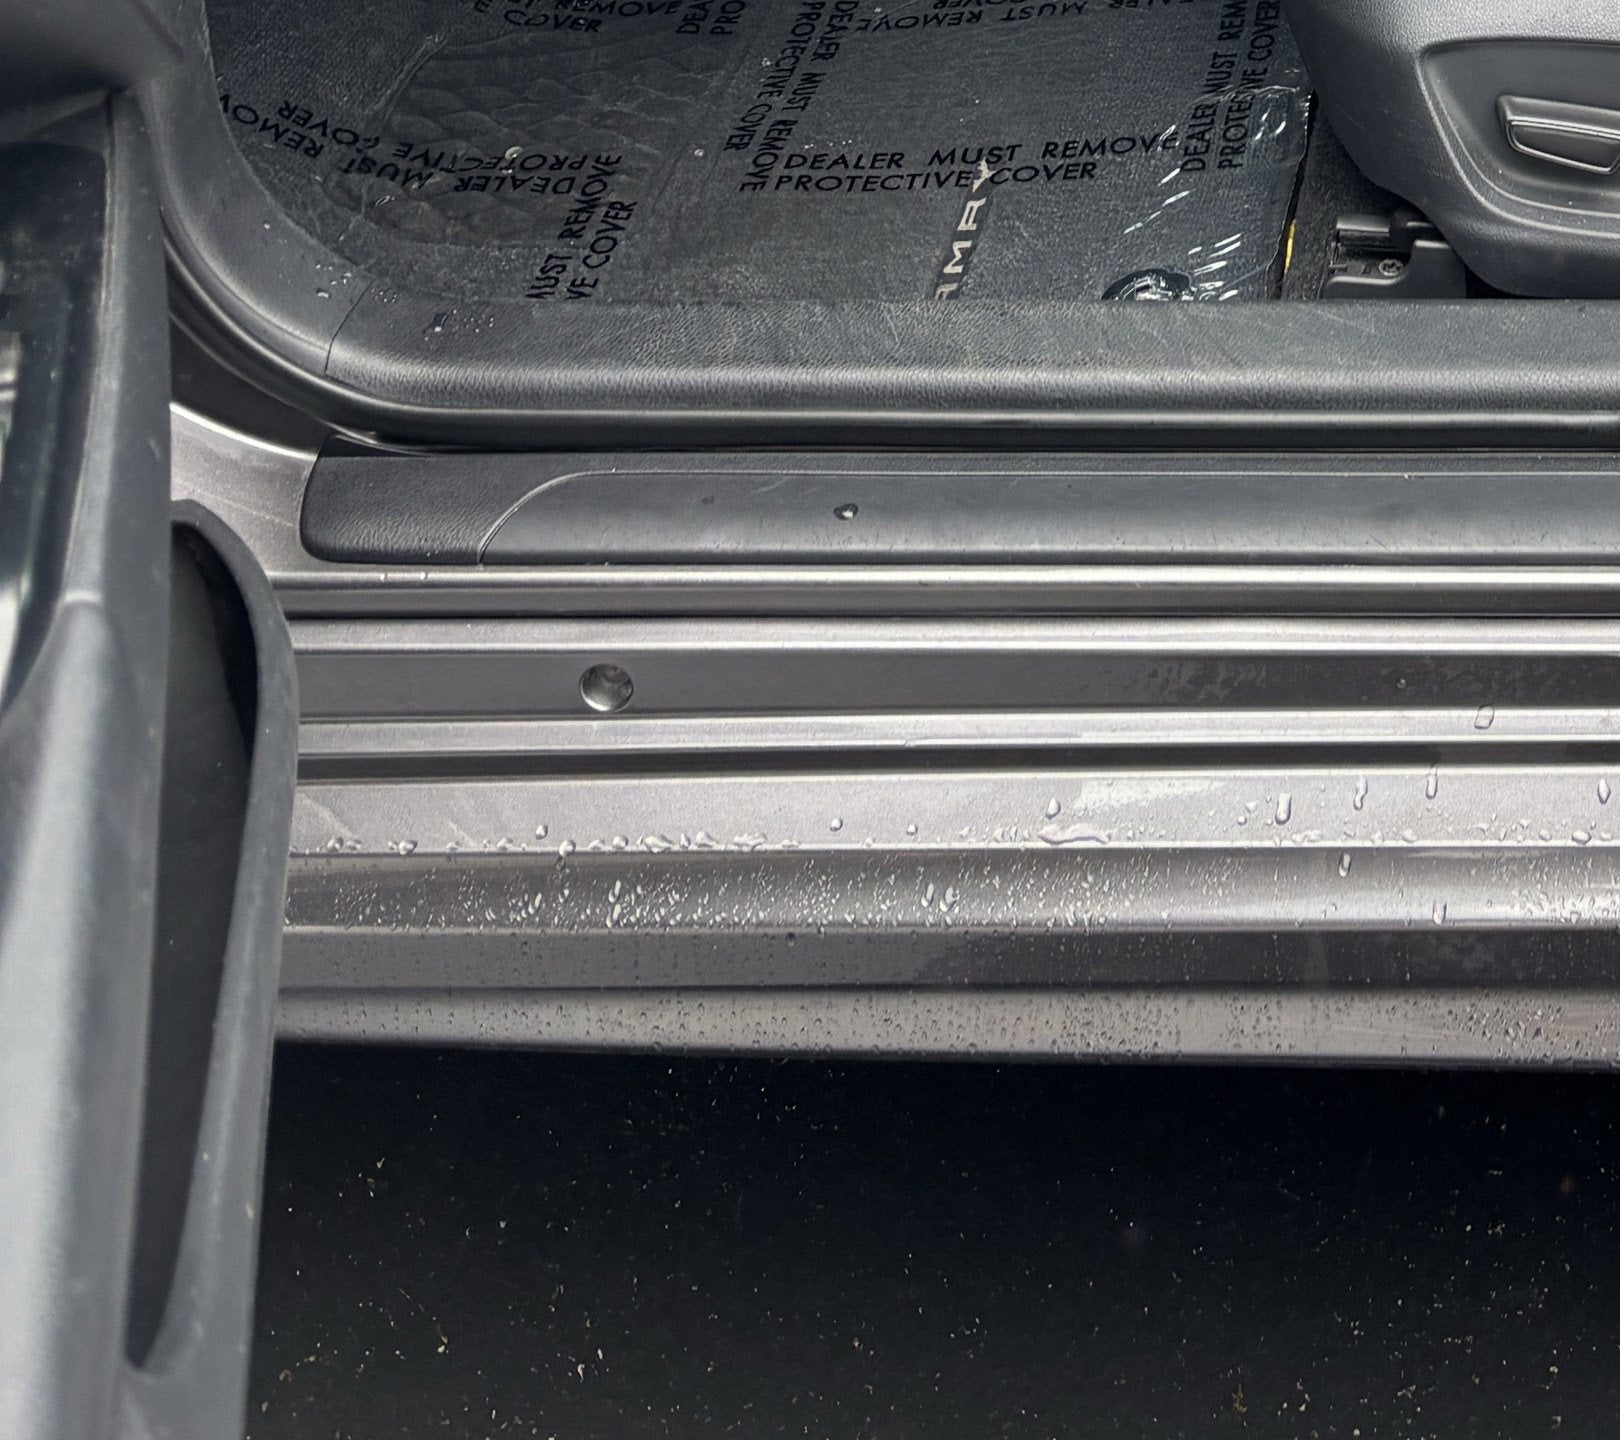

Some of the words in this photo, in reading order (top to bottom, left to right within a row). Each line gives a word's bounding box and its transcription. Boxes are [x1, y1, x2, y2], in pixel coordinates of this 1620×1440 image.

[503, 9, 602, 32] COVER
[854, 9, 983, 32] REMOVE
[1001, 0, 1087, 21] MUST
[757, 1, 825, 99] PROTECTIVE
[811, 0, 860, 62] DEALER
[1248, 0, 1282, 61] COVER
[782, 73, 827, 111] MUST
[724, 104, 772, 151] COVER
[1180, 103, 1219, 172] DEALER
[1202, 52, 1238, 94] MUST
[393, 142, 588, 172] PROTECTIVE
[739, 120, 798, 192] REMOVE
[784, 152, 905, 170] DEALER
[928, 144, 1022, 166] MUST
[1041, 131, 1178, 159] REMOVE
[339, 157, 434, 189] MUST
[454, 175, 576, 194] DEALER
[775, 171, 974, 192] PROTECTIVE
[989, 162, 1097, 185] COVER
[558, 155, 622, 240] REMOVE
[582, 201, 637, 269] COVER
